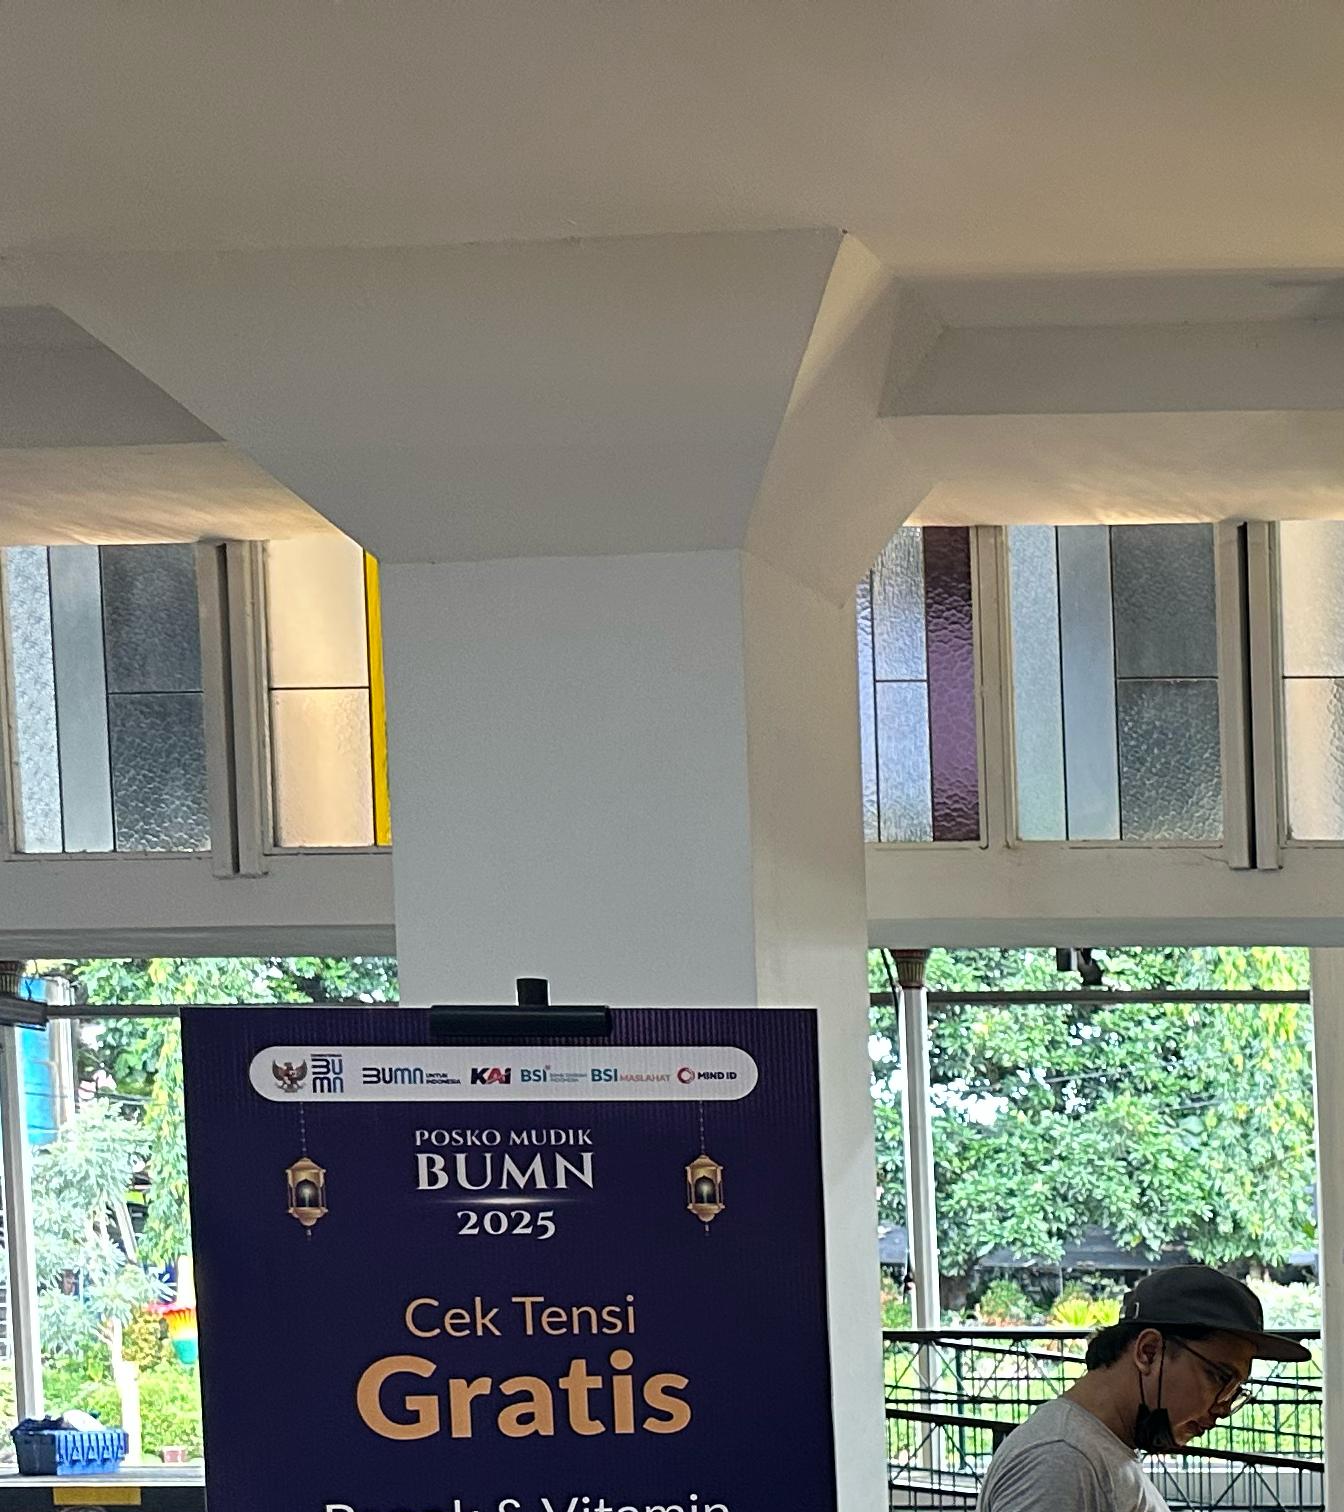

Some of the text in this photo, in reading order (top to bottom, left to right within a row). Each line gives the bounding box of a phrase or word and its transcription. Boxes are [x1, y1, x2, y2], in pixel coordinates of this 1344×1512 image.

[471, 1067, 512, 1085] KAI
[520, 1069, 547, 1083] BSI
[591, 1068, 618, 1083] BSI
[620, 1074, 671, 1083] MASLAHAT
[726, 1071, 738, 1081] ID
[415, 1128, 594, 1147] POSKO MUDIK
[415, 1152, 595, 1192] BUMN
[457, 1209, 557, 1241] 2025
[404, 1294, 636, 1339] Cek Tensi
[356, 1348, 692, 1442] Gratis
